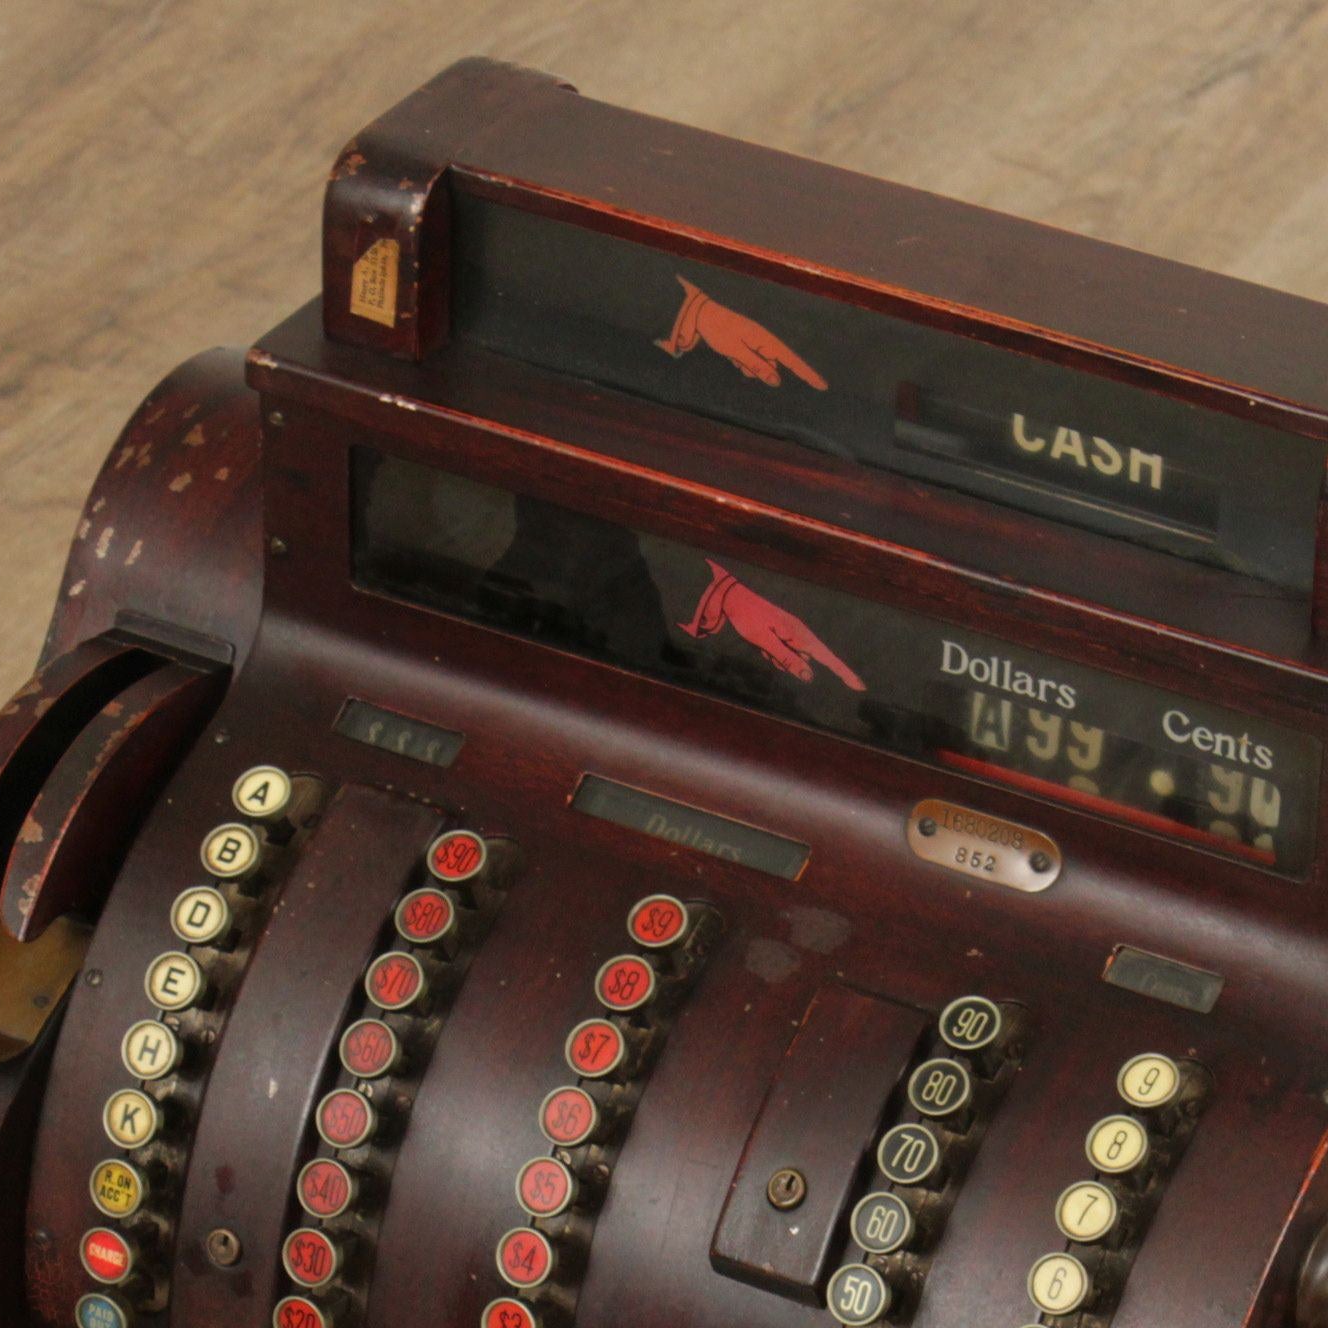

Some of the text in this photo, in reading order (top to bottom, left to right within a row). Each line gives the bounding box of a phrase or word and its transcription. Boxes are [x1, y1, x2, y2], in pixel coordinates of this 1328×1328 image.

[940, 640, 1076, 710] Dollars
[1162, 710, 1273, 770] Cents
[249, 780, 271, 806] A
[218, 840, 242, 863] B
[436, 840, 476, 874] $90
[955, 847, 998, 872] 852
[187, 903, 212, 928] D
[404, 900, 441, 934] $80
[647, 906, 674, 937] $9
[163, 968, 186, 995] E
[374, 962, 413, 998] $70
[612, 967, 640, 1000] $8
[953, 1008, 988, 1042] 90
[137, 1036, 162, 1065] H
[582, 1031, 612, 1065] $7
[922, 1071, 957, 1106] 80
[1137, 1066, 1161, 1096] 9
[118, 1102, 141, 1135] K
[552, 1098, 582, 1134] $6
[891, 1134, 927, 1173] 70
[1106, 1130, 1128, 1160] 8
[306, 1169, 345, 1207] $40
[530, 1170, 560, 1206] $5
[866, 1204, 898, 1243] 60
[1075, 1193, 1099, 1226] 7
[293, 1238, 325, 1277] $30
[508, 1241, 538, 1276] $4
[840, 1275, 872, 1315] 50
[1048, 1265, 1068, 1301] 6
